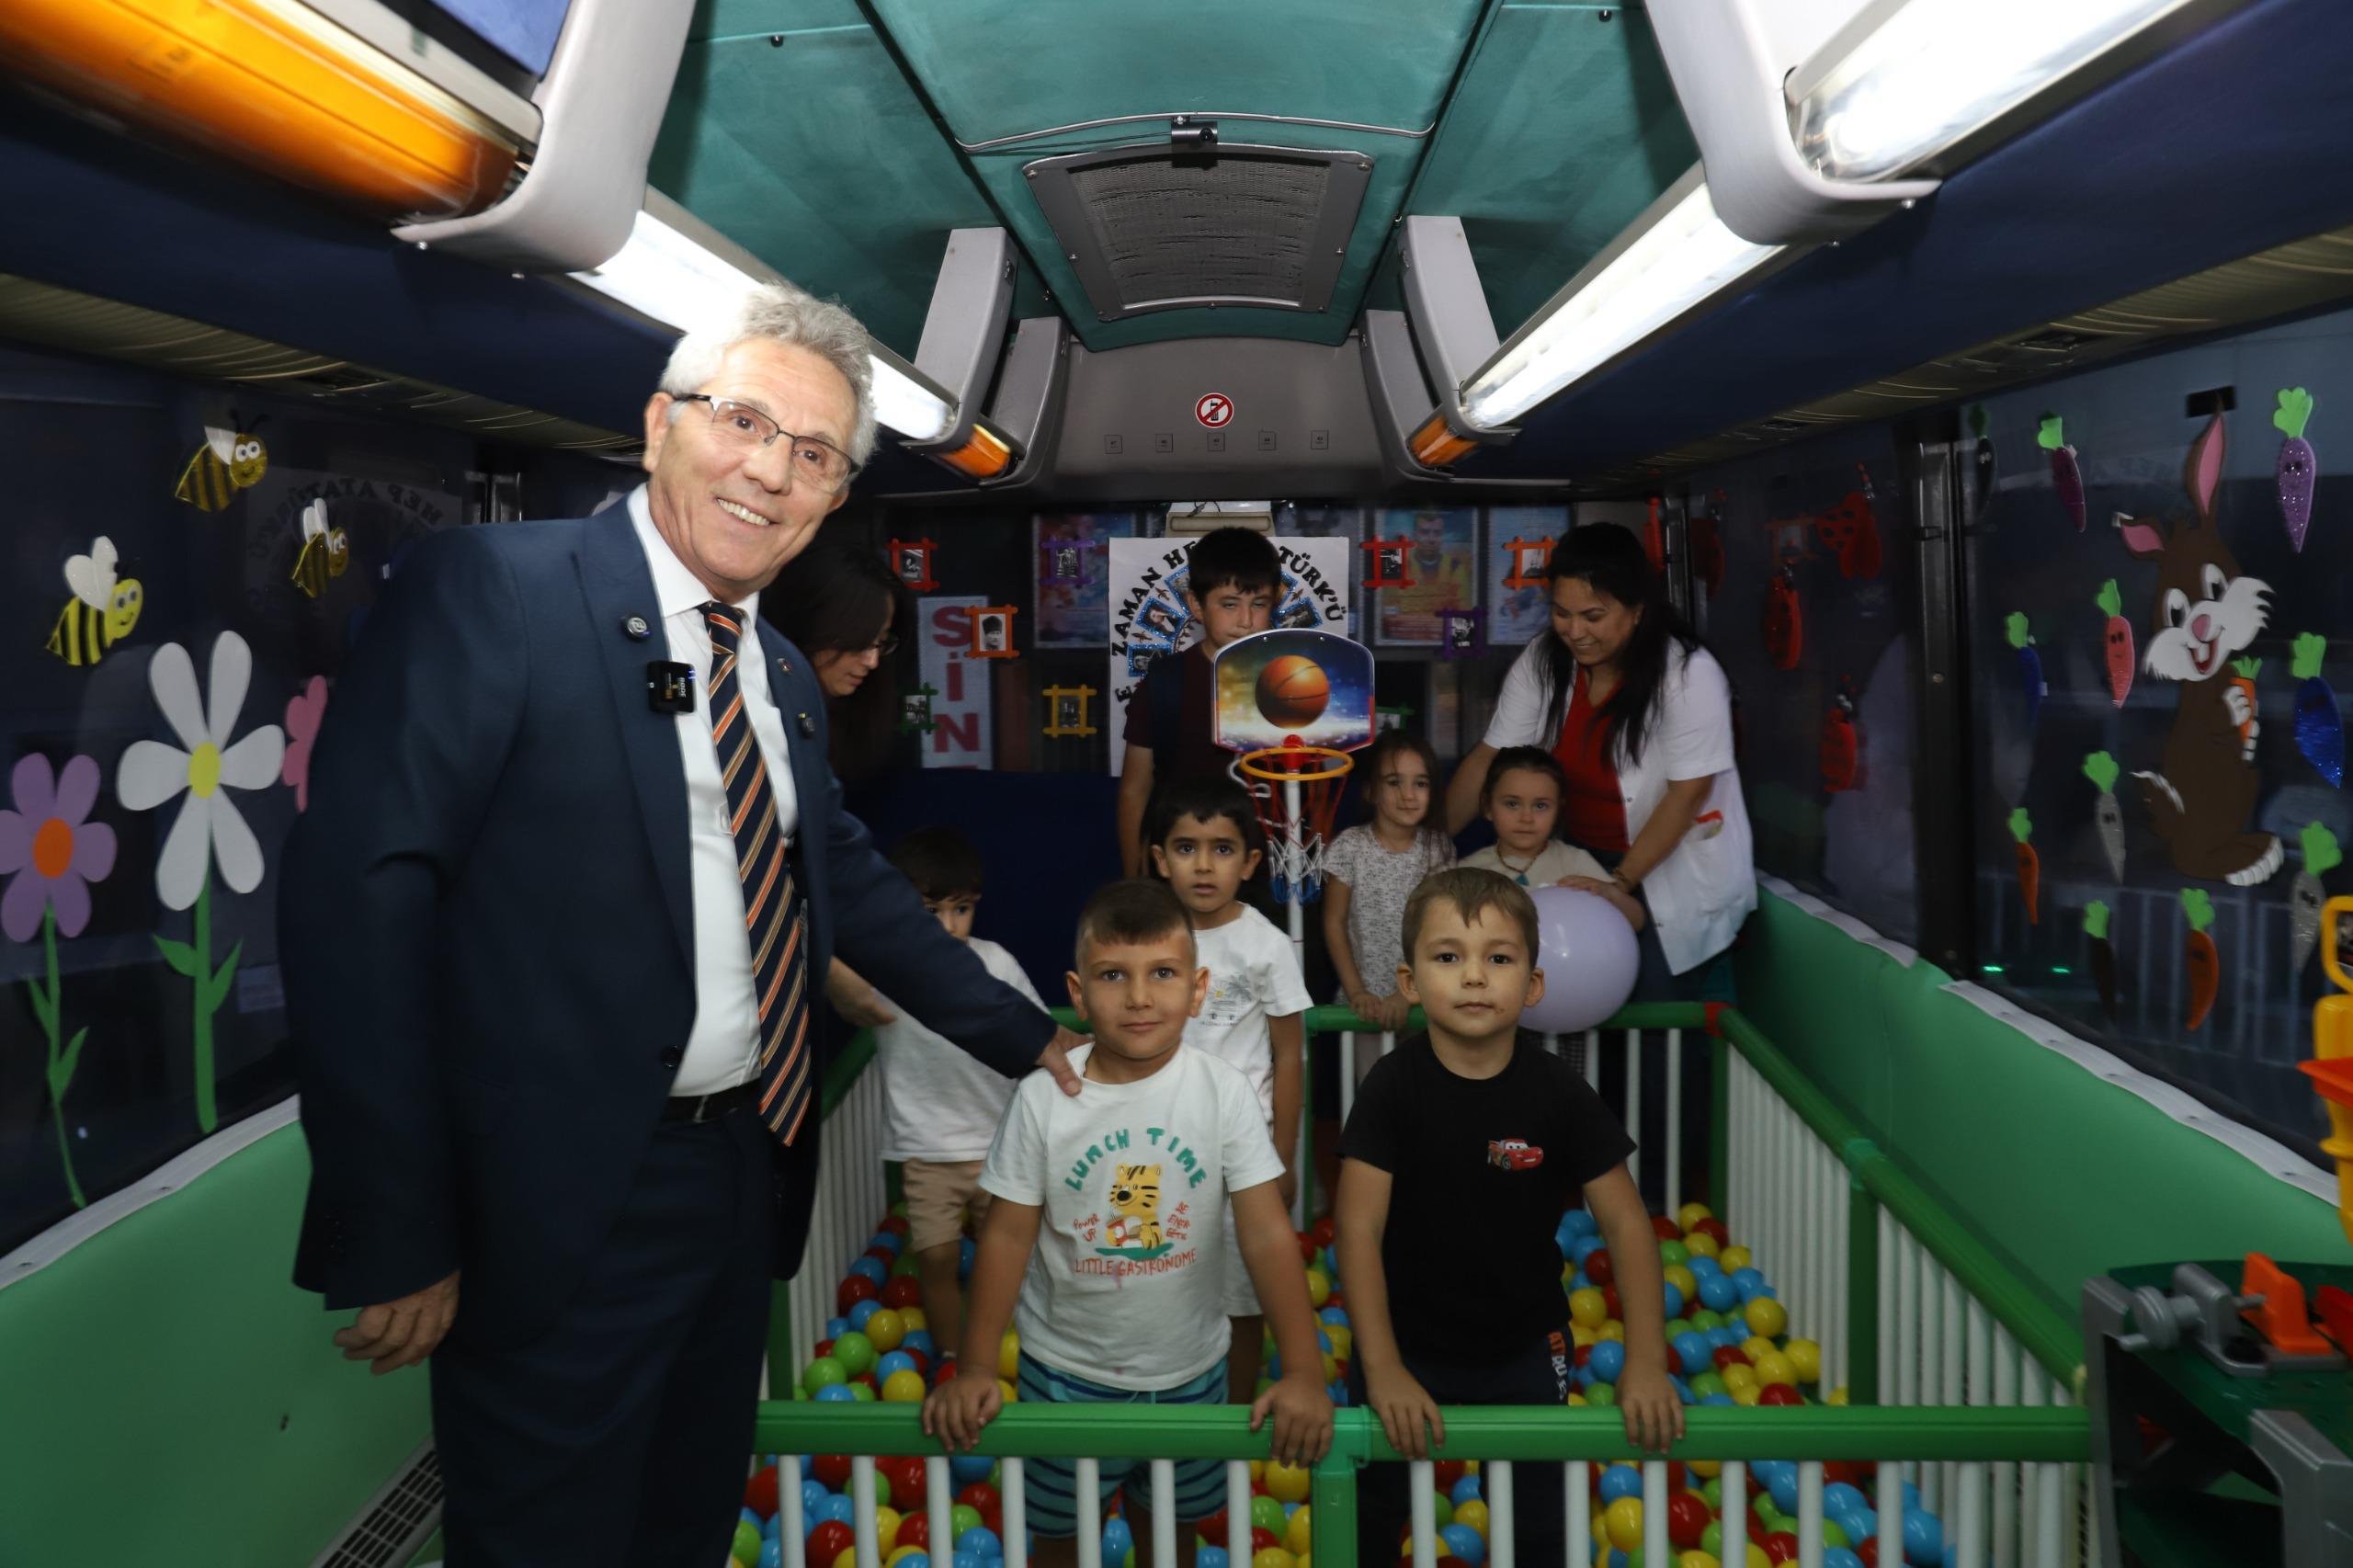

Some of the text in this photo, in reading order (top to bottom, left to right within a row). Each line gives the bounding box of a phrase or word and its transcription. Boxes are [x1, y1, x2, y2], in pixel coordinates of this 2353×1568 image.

[1111, 567, 1163, 657] ZAMAN
[1279, 545, 1344, 622] TÜRK'Ü
[1064, 1127, 1207, 1192] LUNCH TIME
[1074, 1247, 1197, 1277] LITTLE GASTRONOME
